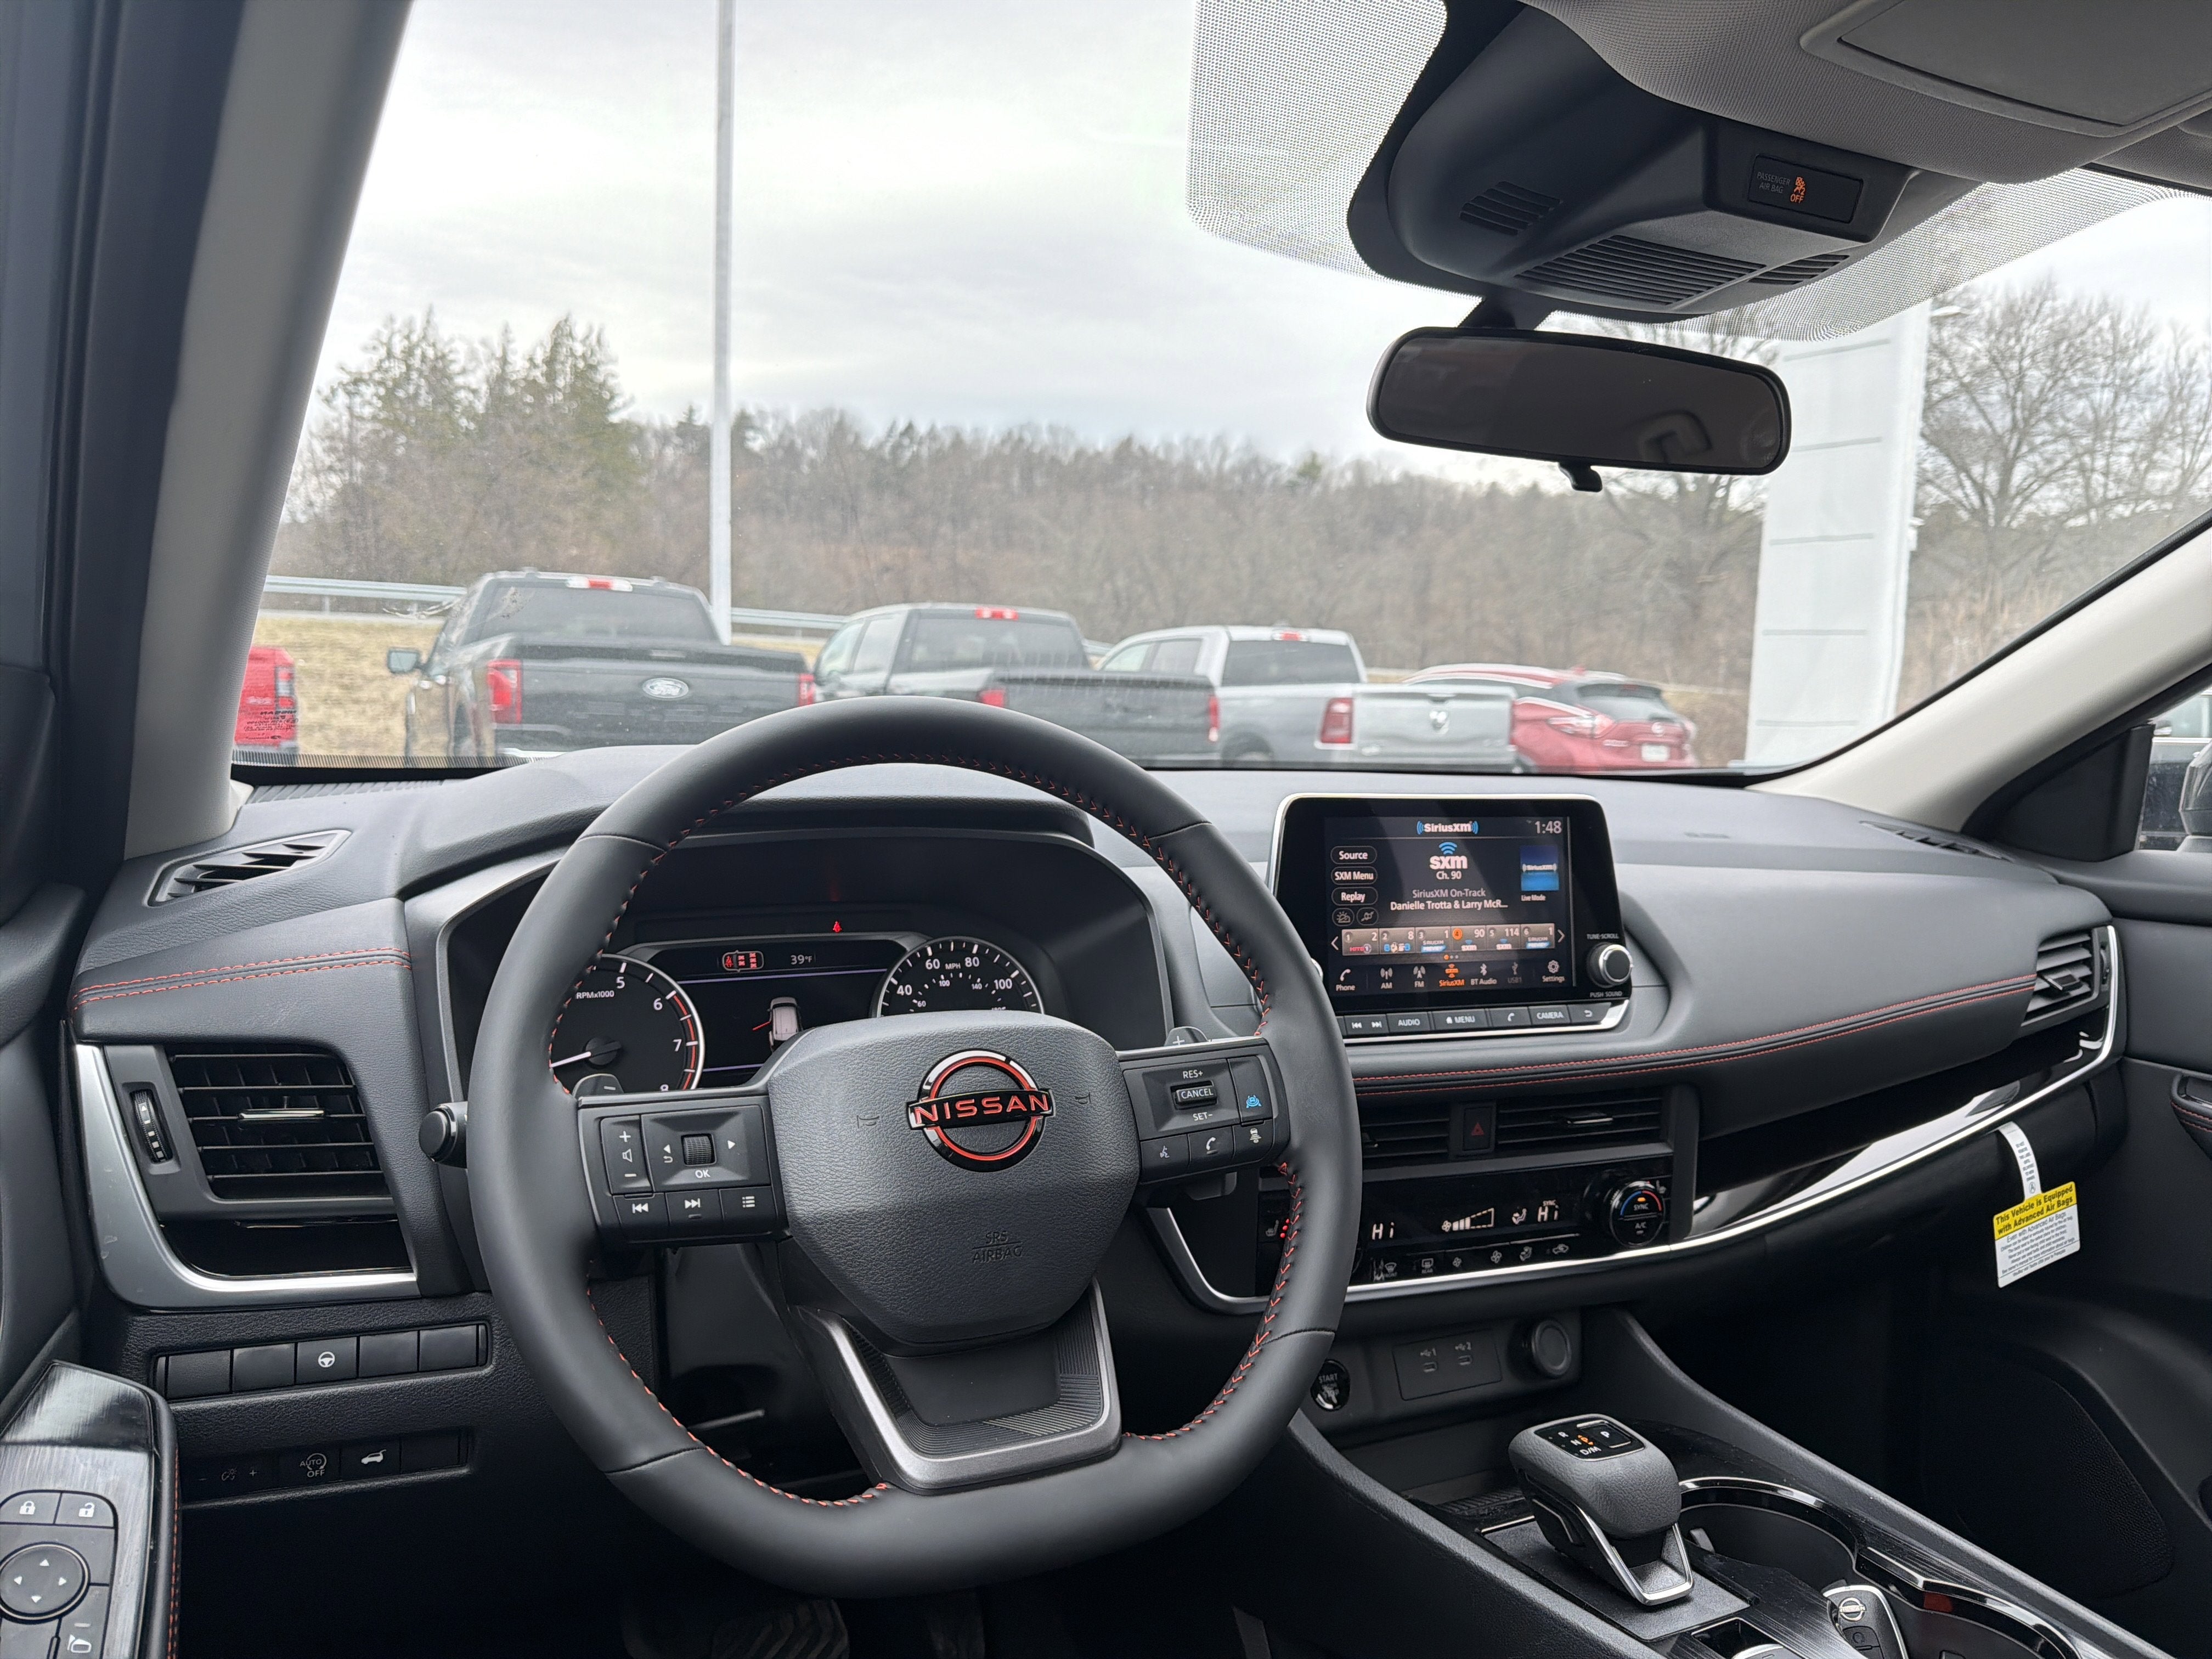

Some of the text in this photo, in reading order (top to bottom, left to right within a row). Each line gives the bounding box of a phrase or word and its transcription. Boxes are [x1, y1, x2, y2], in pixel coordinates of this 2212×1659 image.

[1757, 171, 1791, 186] PASSENGER
[1771, 184, 1784, 194] BAG
[1790, 194, 1804, 204] OFF
[1534, 821, 1562, 834] 1:48
[1339, 850, 1368, 860] Source
[1334, 871, 1374, 881] SXM Menu
[1436, 871, 1462, 880] Ch. 90
[1341, 891, 1366, 902] Replay
[1412, 888, 1486, 899] SiriusXM On-Track
[1390, 901, 1425, 911] Danielle
[1426, 900, 1452, 910] Trotta
[1453, 900, 1460, 909] &
[1462, 900, 1482, 911] Larry
[1408, 930, 1414, 940] 8
[1444, 929, 1449, 939] 1
[1474, 929, 1486, 938] 90
[1505, 928, 1520, 937] 114
[1548, 927, 1553, 935] 1
[1372, 932, 1378, 941] 2
[790, 955, 812, 965] 39°F
[925, 958, 940, 970] 60
[964, 956, 980, 967] 80
[616, 976, 625, 989] 5
[994, 978, 1013, 990] 100
[1438, 979, 1465, 987] SiriusXM
[1542, 975, 1565, 983] Settings
[896, 984, 912, 996] 40
[653, 997, 663, 1011] 6
[1455, 1015, 1475, 1023] MENU
[1537, 1011, 1564, 1020] CAMERA
[1398, 1018, 1420, 1026] AUDIO
[673, 1039, 682, 1052] 7
[1182, 1069, 1203, 1079] RES+
[1181, 1088, 1214, 1099] CANCEL
[913, 1093, 1049, 1125] NISSAN
[695, 1169, 710, 1178] OK
[1996, 1184, 2073, 1226] This Vehicle is Equipped
[1997, 1196, 2073, 1235] with Advanced Air Bags
[985, 1230, 1008, 1244] SRS
[1318, 1373, 1338, 1384] START
[1579, 1446, 1602, 1456] D/M
[300, 1458, 322, 1468] AUTO
[307, 1469, 325, 1478] OFF
